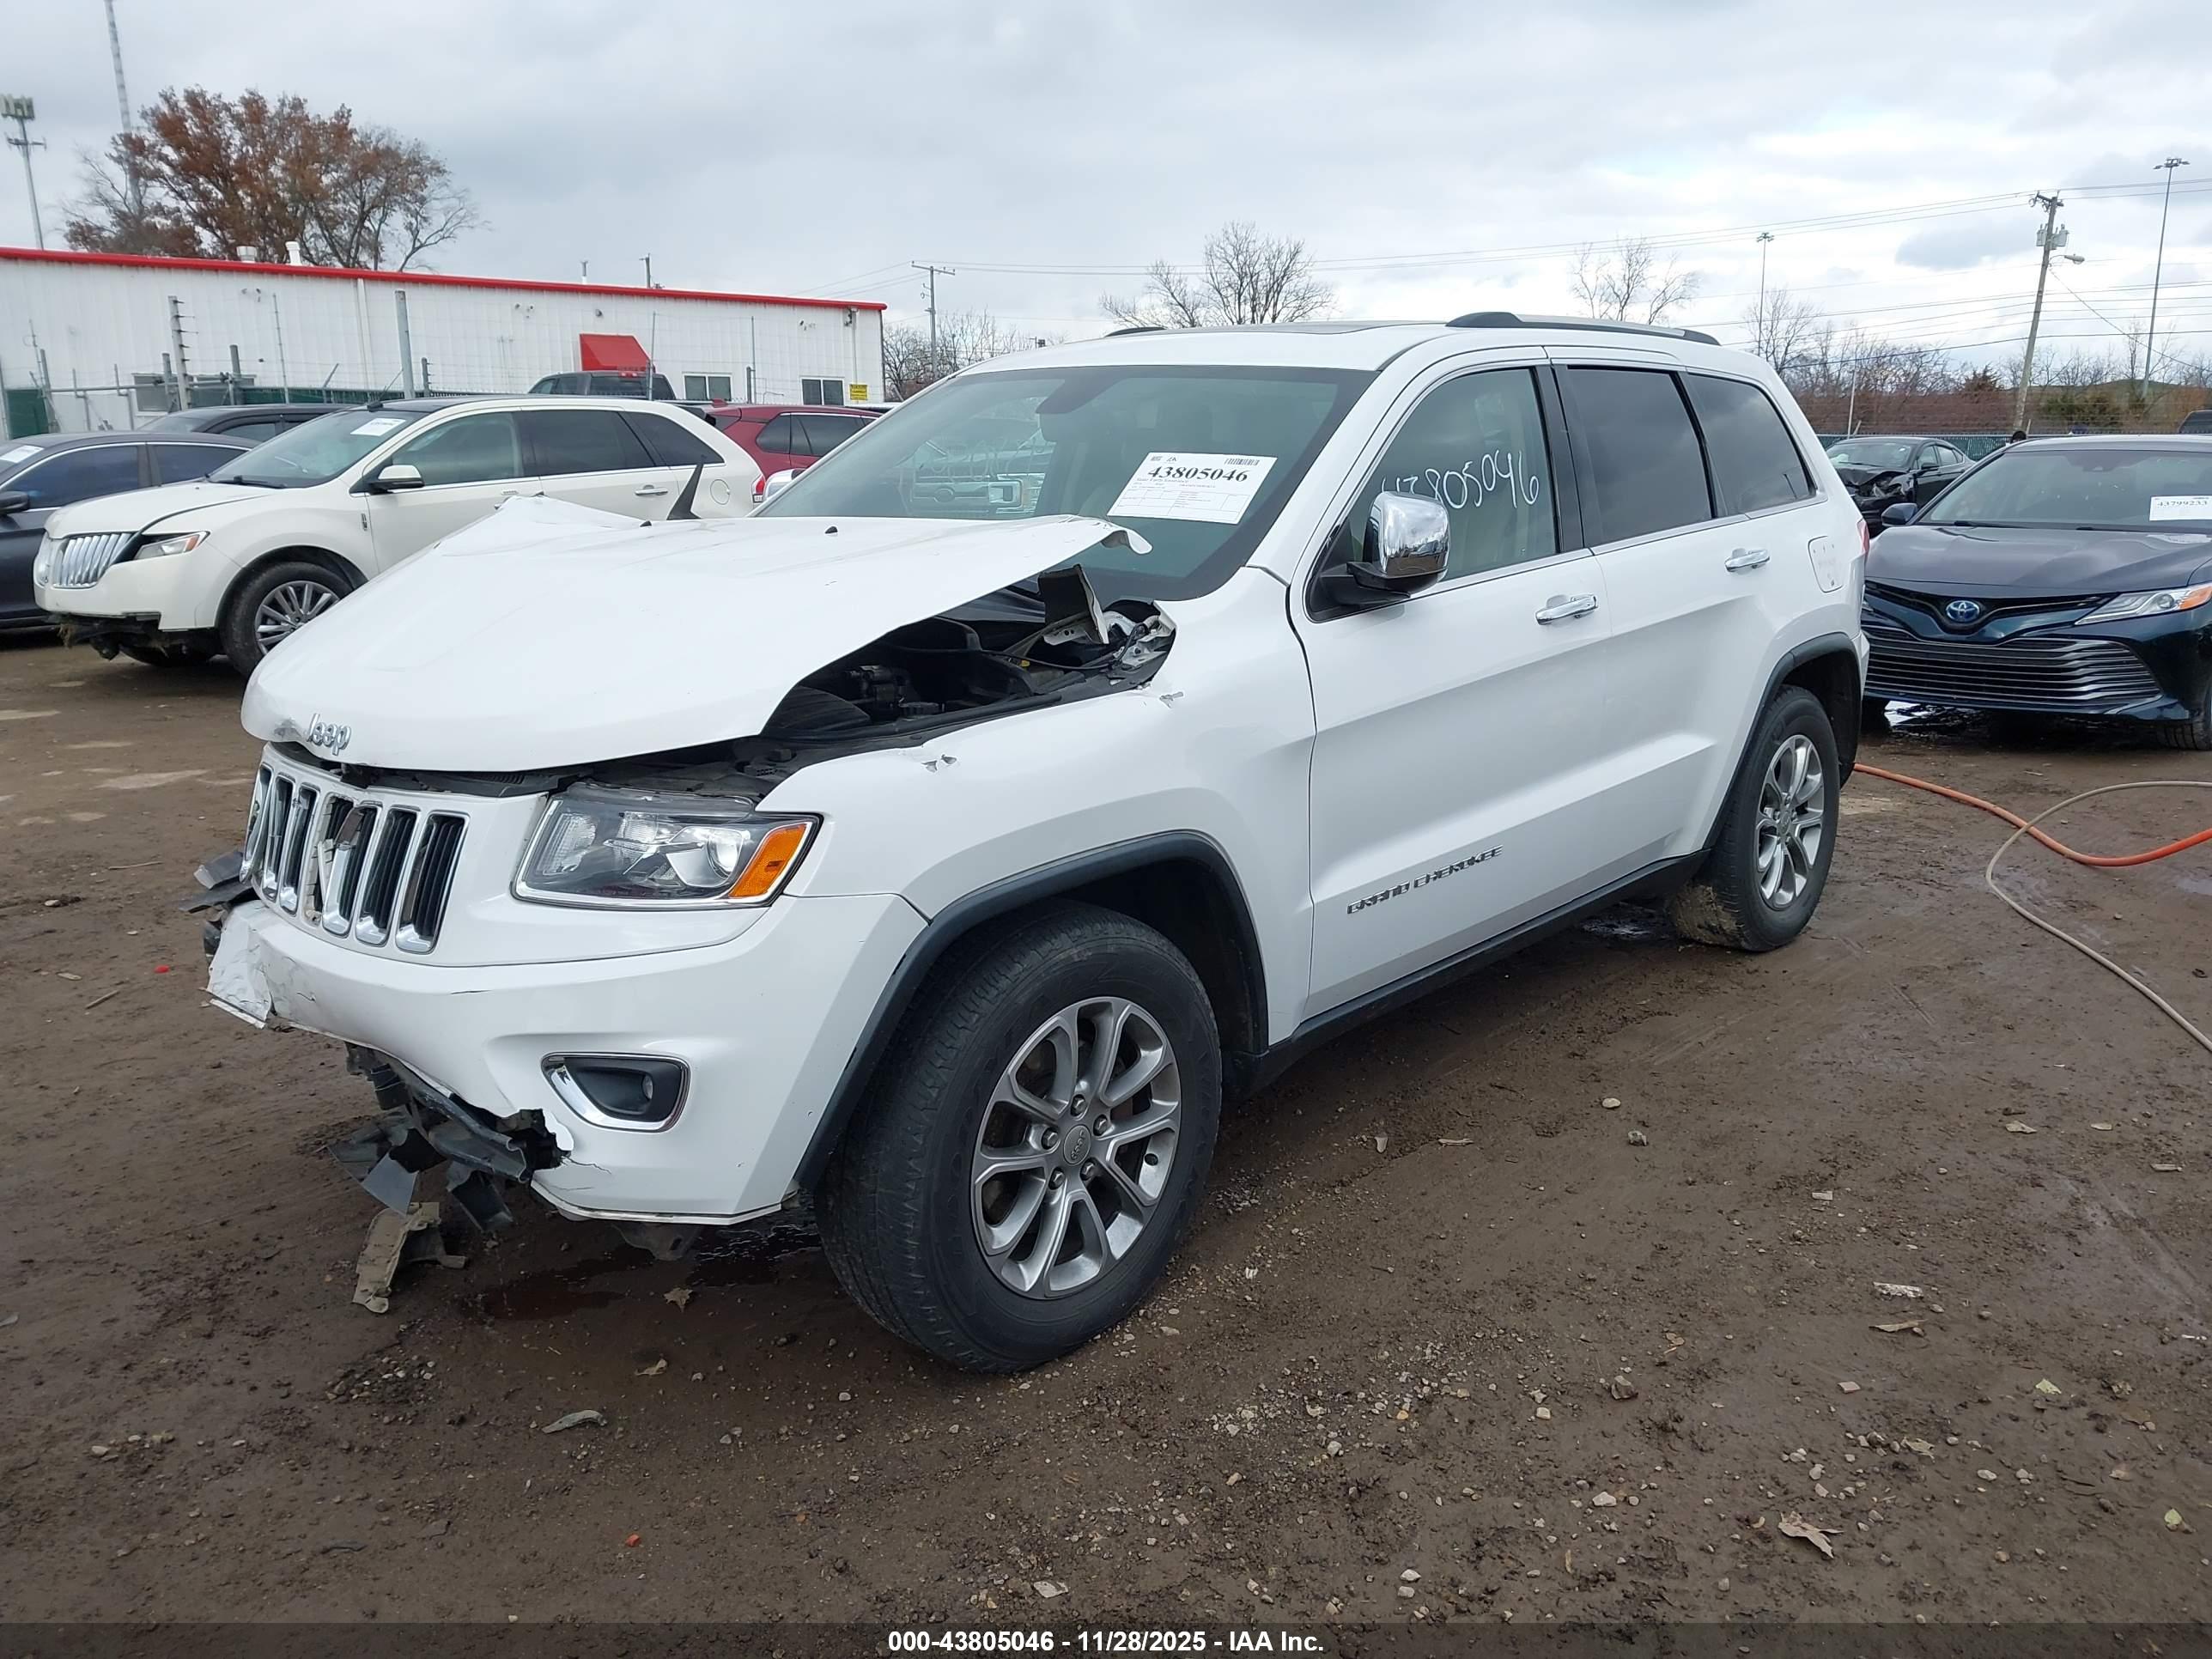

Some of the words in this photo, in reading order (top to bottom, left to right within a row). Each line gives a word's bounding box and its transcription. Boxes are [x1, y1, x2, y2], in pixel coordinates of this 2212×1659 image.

[1147, 465, 1251, 482] 43805046
[307, 713, 352, 757] Jeep
[1346, 881, 1411, 915] GRAND
[1413, 844, 1504, 889] CHEROKEE
